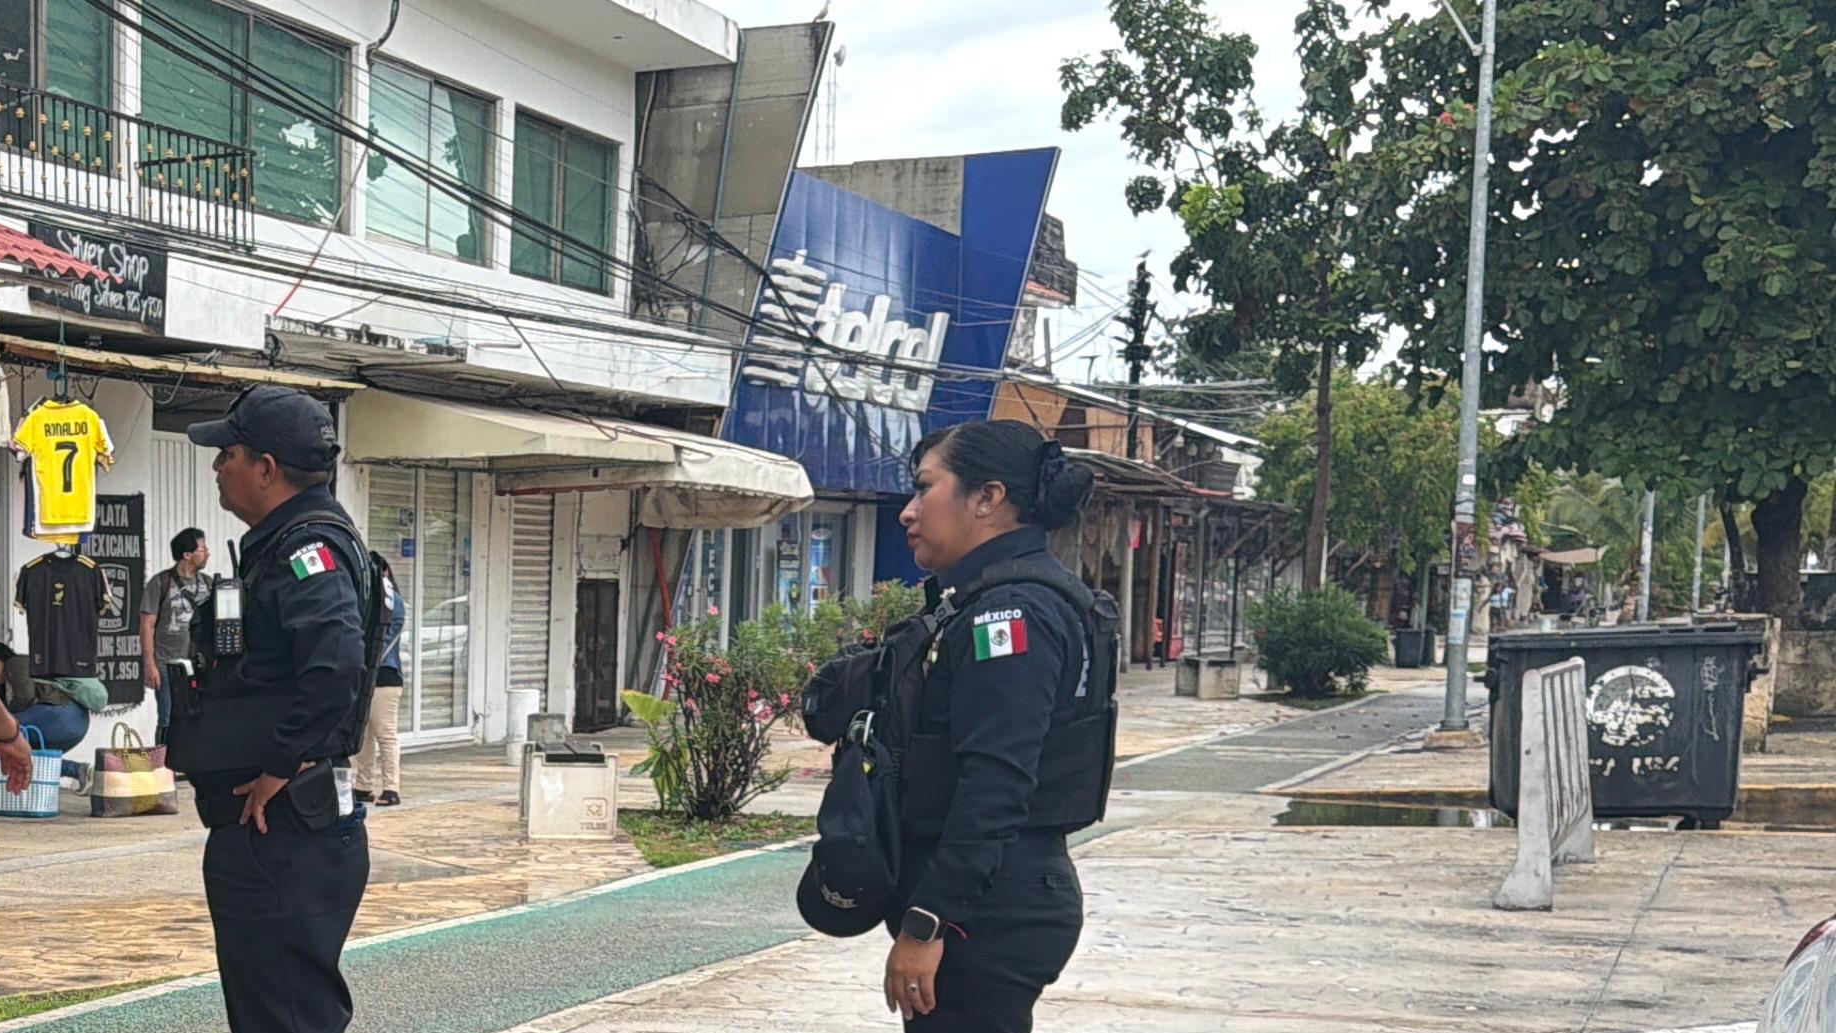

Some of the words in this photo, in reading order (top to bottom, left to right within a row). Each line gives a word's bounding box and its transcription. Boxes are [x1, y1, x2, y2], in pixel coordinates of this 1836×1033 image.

[108, 243, 149, 291] Shop
[55, 441, 78, 492] 7
[974, 609, 1022, 625] MÉXICO
[116, 635, 142, 656] SILVER
[107, 661, 116, 681] Y
